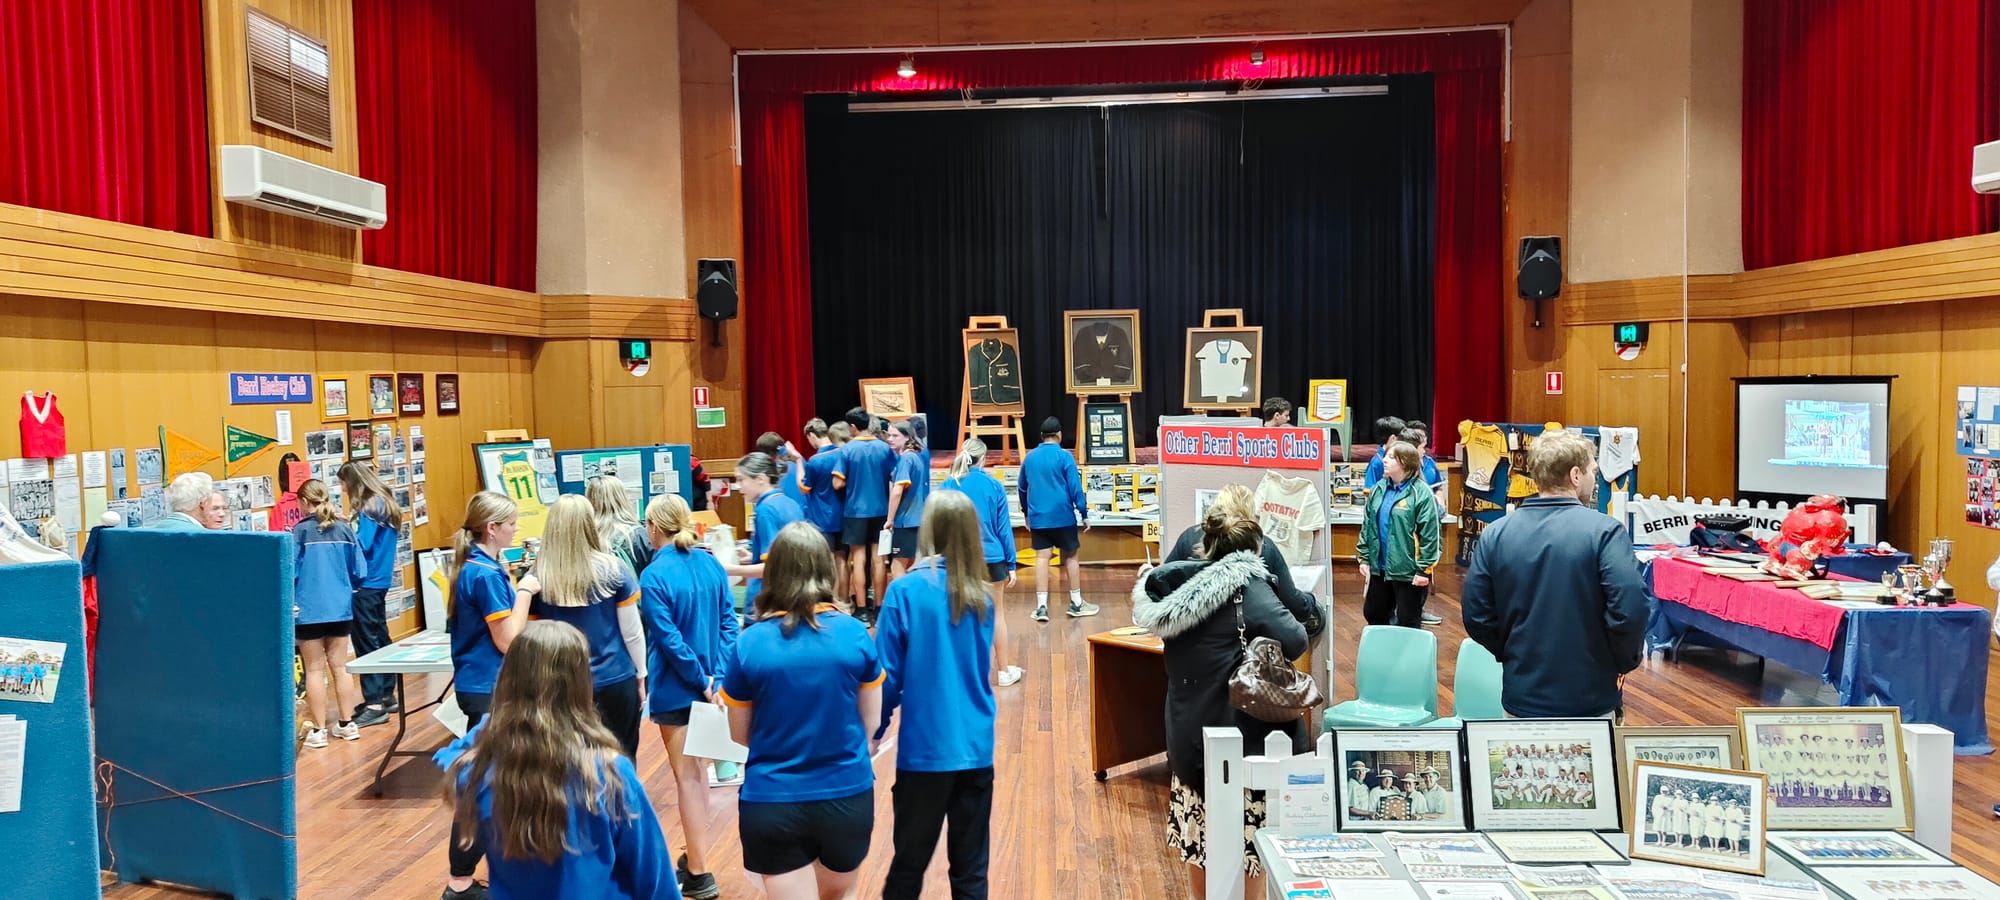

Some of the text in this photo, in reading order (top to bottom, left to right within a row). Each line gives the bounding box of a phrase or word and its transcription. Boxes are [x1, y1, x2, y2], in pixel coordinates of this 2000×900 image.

[237, 376, 306, 400] Berri Hockey Club
[1166, 430, 1319, 463] Other Berri Sports Clubs
[509, 476, 532, 500] 11
[284, 507, 304, 524] 199
[1643, 516, 1689, 533] BERRI
[1147, 523, 1160, 536] Be
